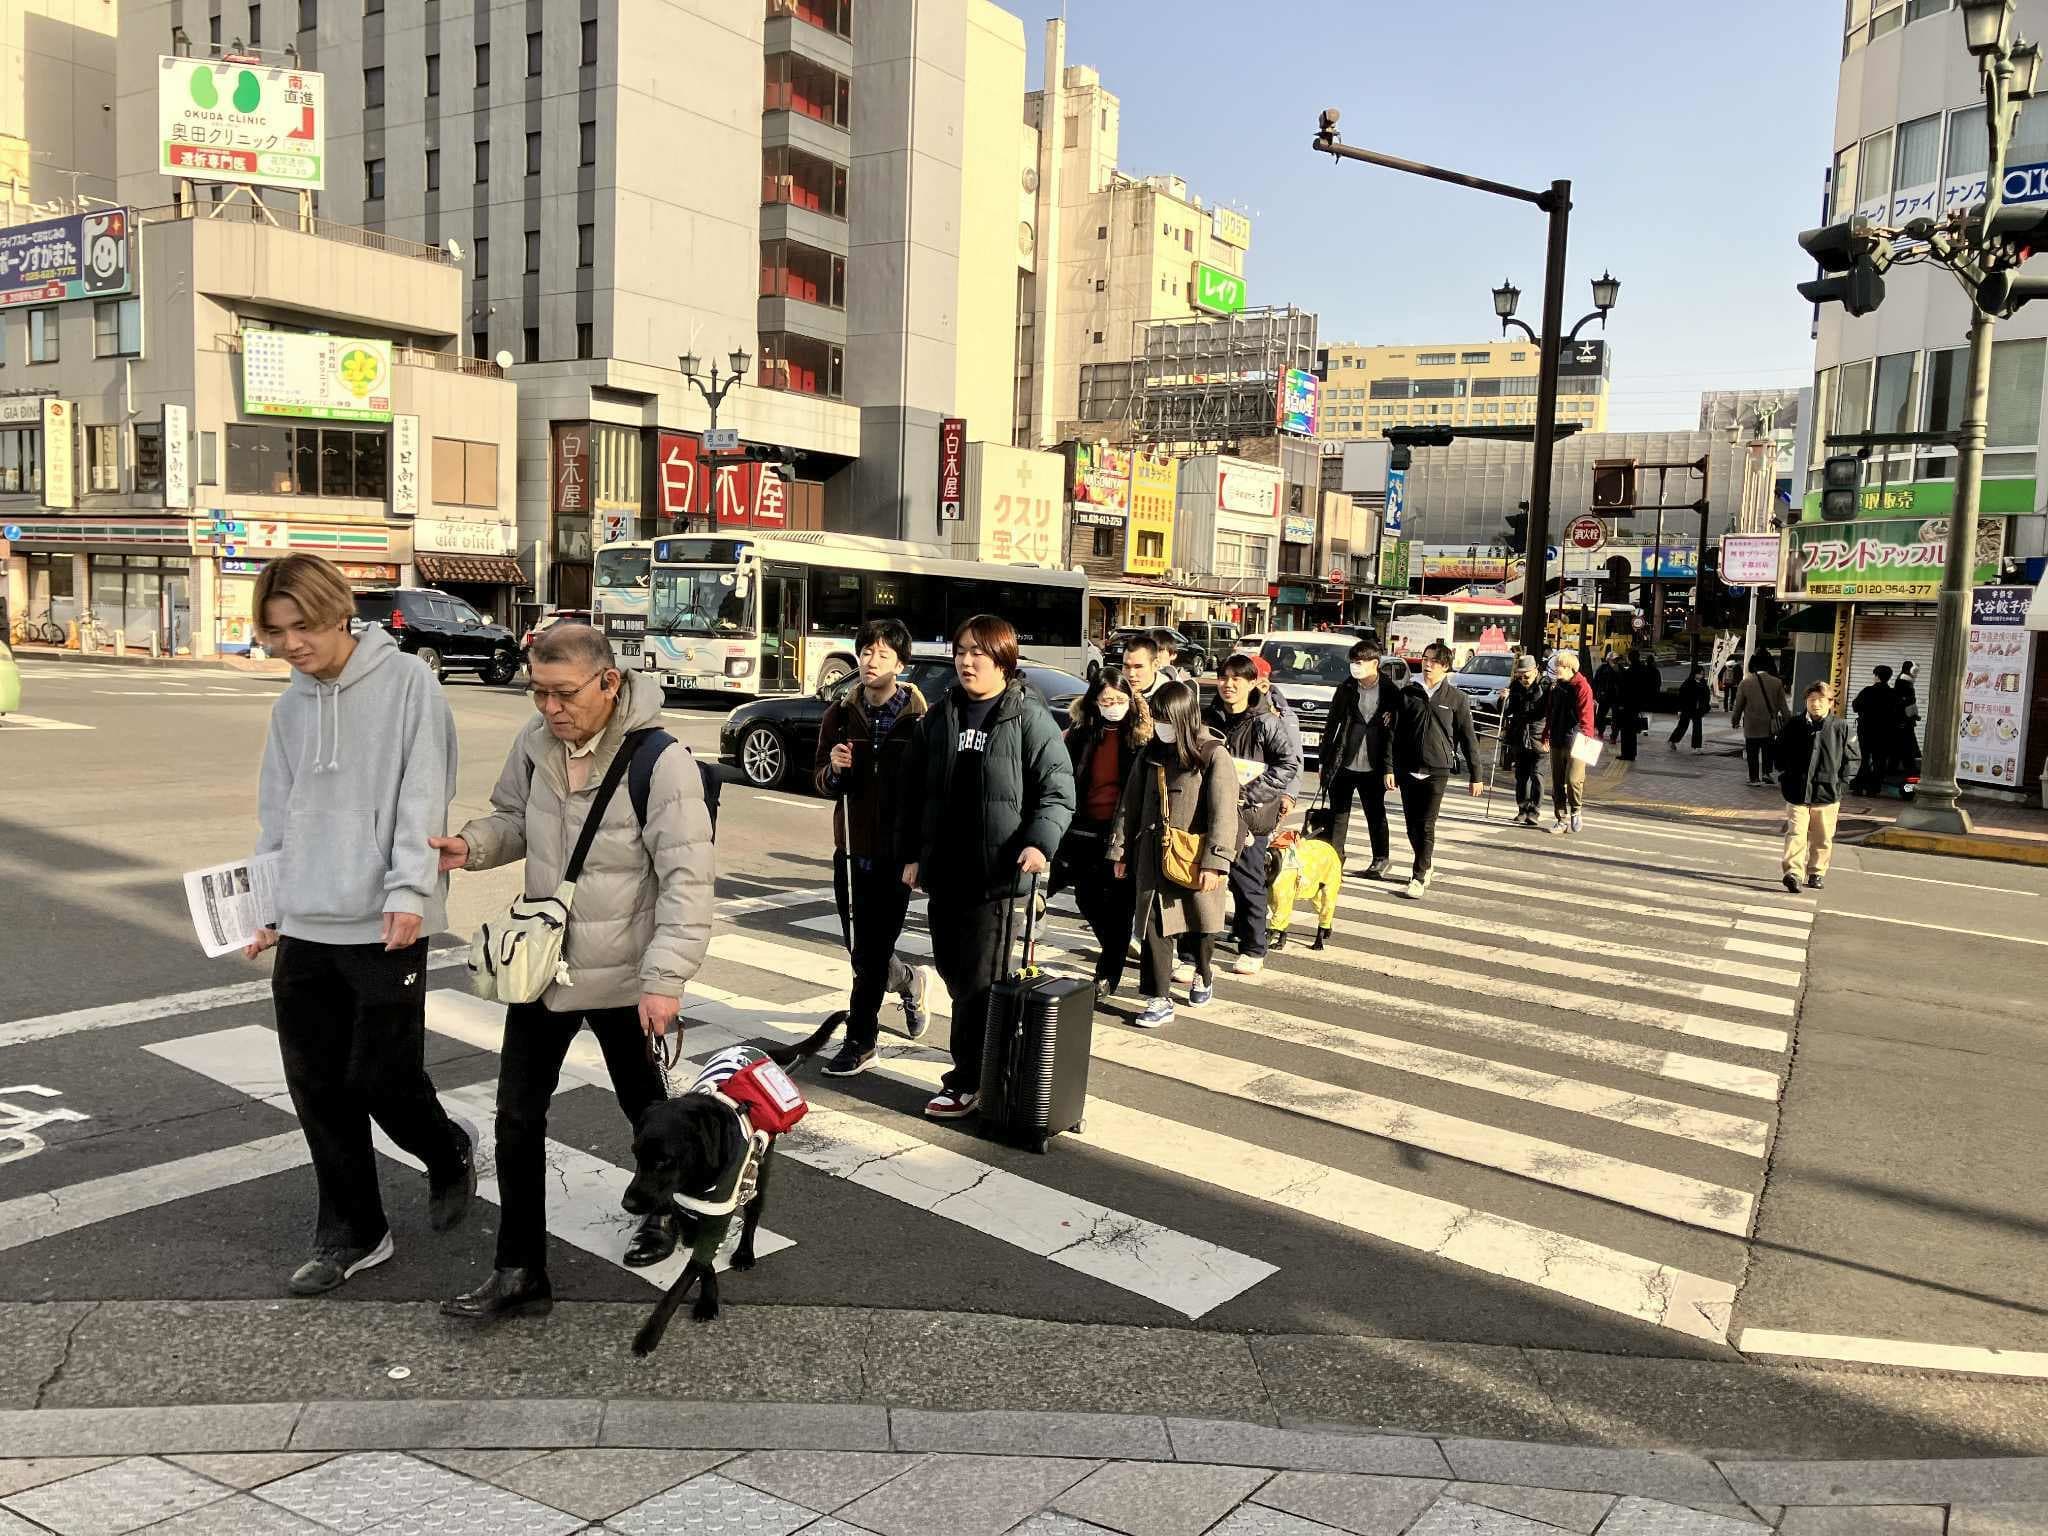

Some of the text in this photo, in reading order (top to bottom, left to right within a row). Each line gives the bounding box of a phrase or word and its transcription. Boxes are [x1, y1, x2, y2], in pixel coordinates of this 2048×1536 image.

[284, 90, 314, 106] 直進
[184, 110, 223, 121] OKUDA
[228, 114, 267, 126] CLINIC
[171, 123, 278, 150] 奥田クリニック
[1205, 271, 1237, 305] レイク
[560, 433, 584, 509] 白木屋
[943, 432, 960, 498] 白木屋
[660, 446, 784, 520] 白木屋
[993, 494, 1052, 528] クスリ
[992, 530, 1049, 561] 宝くじ
[1574, 528, 1600, 540] 消火栓
[1802, 538, 1947, 572] ブランドアップル
[1856, 584, 1932, 594] 0120-954-377
[1973, 598, 2032, 615] 大谷餃子店
